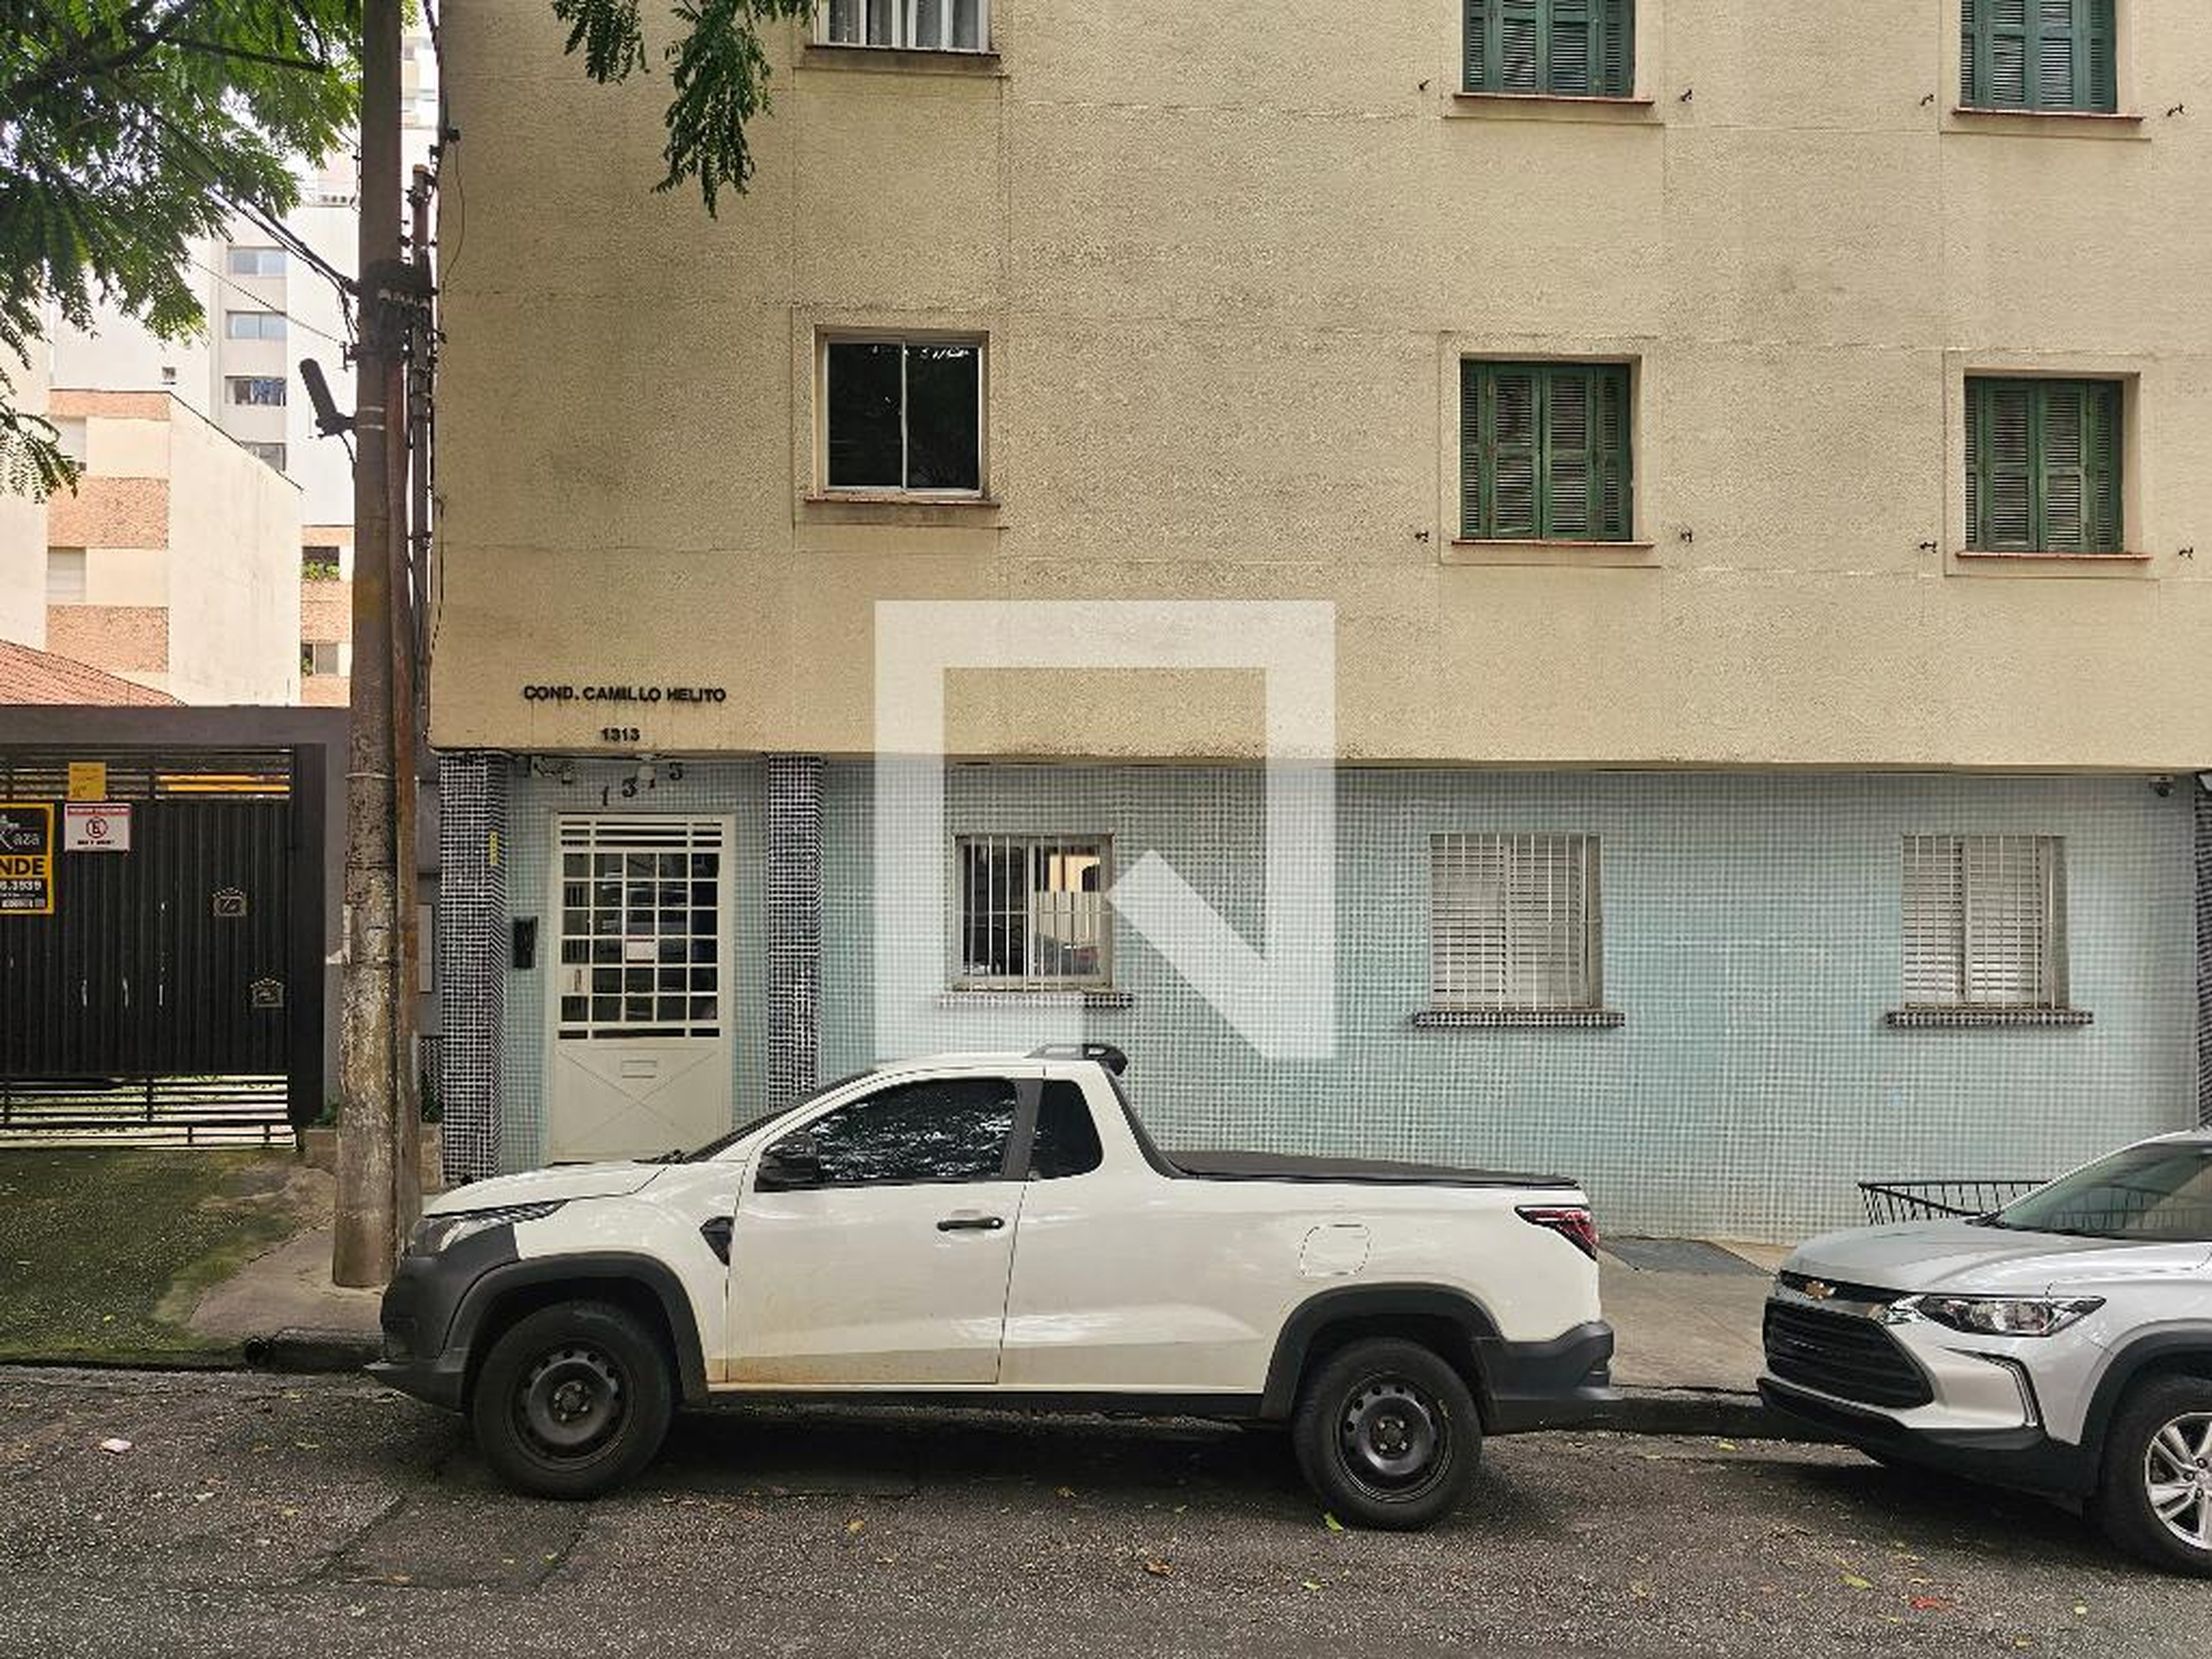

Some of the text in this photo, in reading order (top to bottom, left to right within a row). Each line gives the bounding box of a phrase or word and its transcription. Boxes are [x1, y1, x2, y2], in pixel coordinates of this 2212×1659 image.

[524, 685, 726, 702] COND. CAMILLO HELITO
[601, 728, 640, 741] 1313
